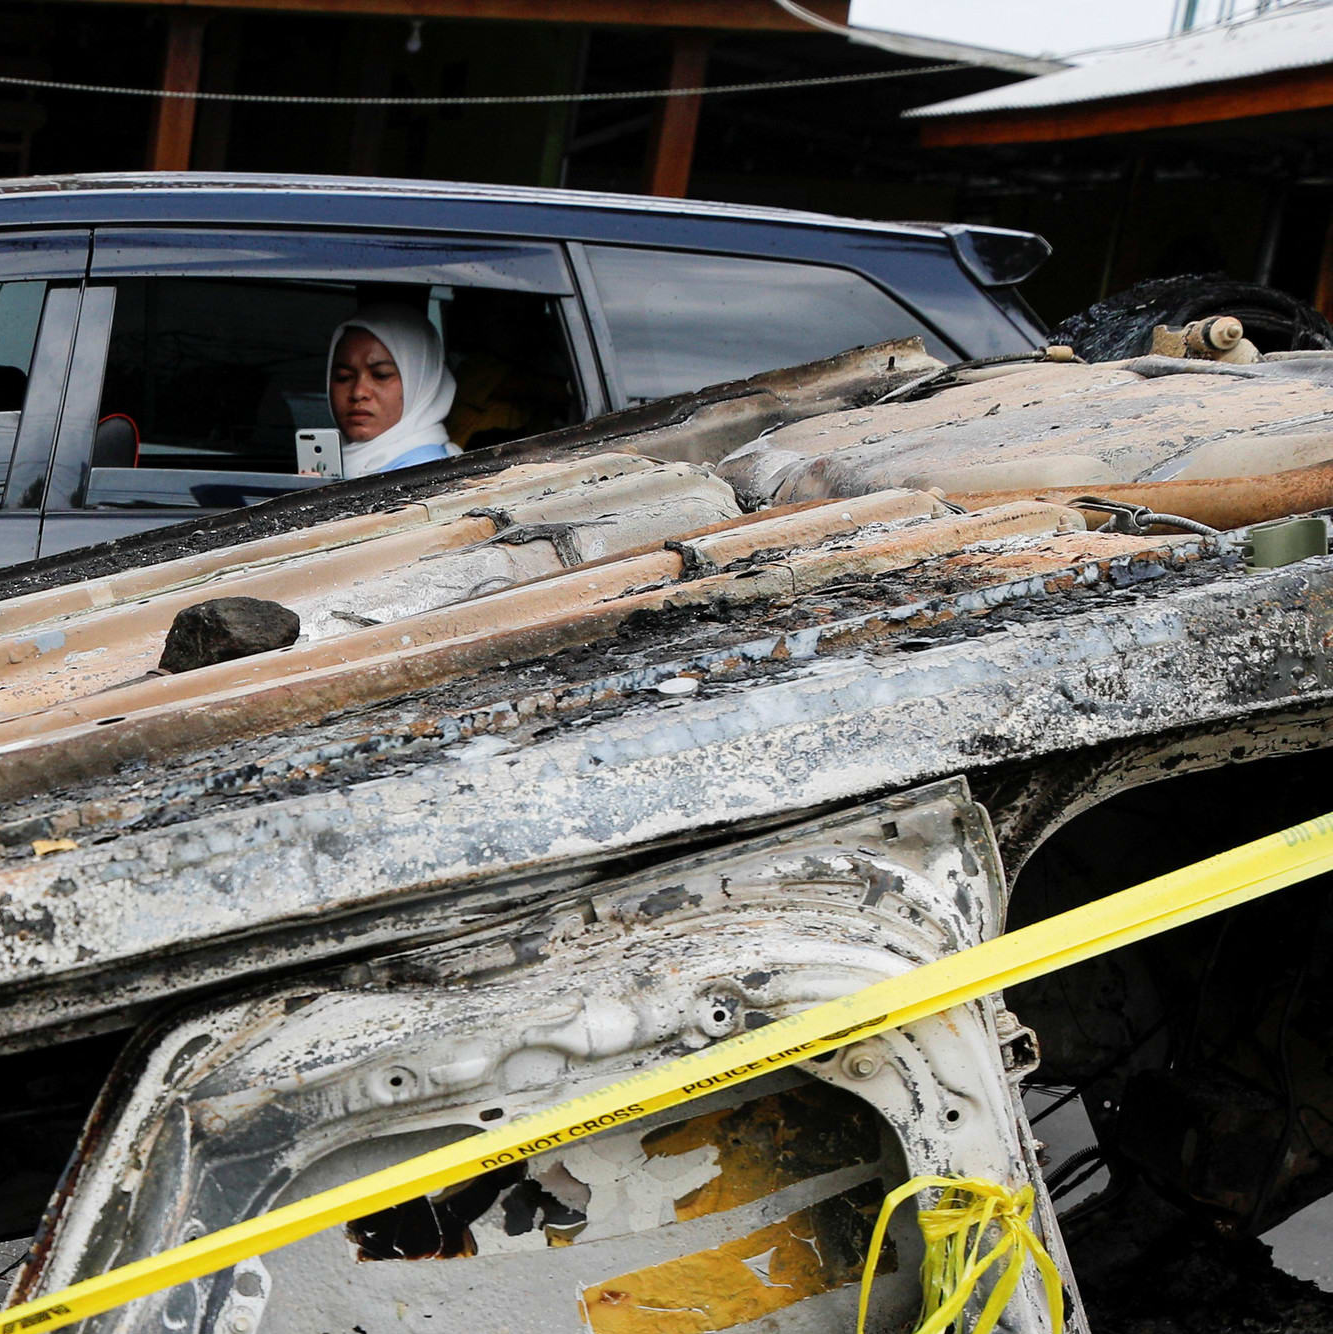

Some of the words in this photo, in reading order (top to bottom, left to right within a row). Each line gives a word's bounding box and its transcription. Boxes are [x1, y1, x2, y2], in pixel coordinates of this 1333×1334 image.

[518, 1132, 562, 1155] NOT
[569, 1103, 645, 1137] CROSS
[683, 1061, 763, 1094] POLICE
[766, 1041, 816, 1063] LINE
